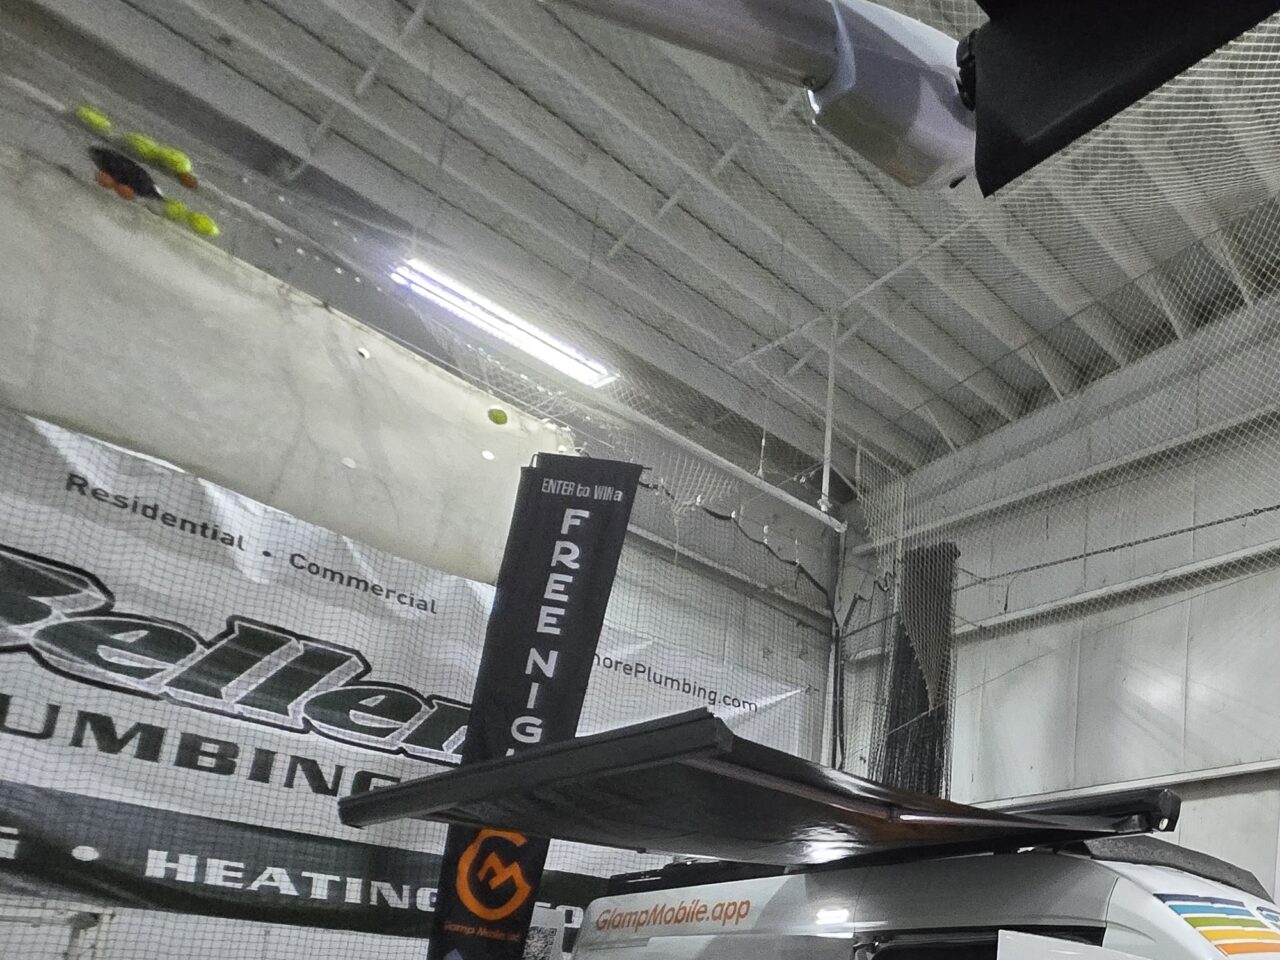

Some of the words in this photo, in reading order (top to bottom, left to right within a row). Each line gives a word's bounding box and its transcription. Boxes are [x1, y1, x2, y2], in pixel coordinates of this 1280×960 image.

[66, 472, 246, 551] Residential
[289, 553, 438, 615] Commercial
[542, 478, 576, 496] ENTER
[576, 483, 591, 498] to
[593, 485, 614, 501] WIN
[613, 489, 624, 502] a
[536, 508, 590, 635] FREE
[505, 648, 558, 757] NIG
[596, 900, 751, 932] GlampMobile.app
